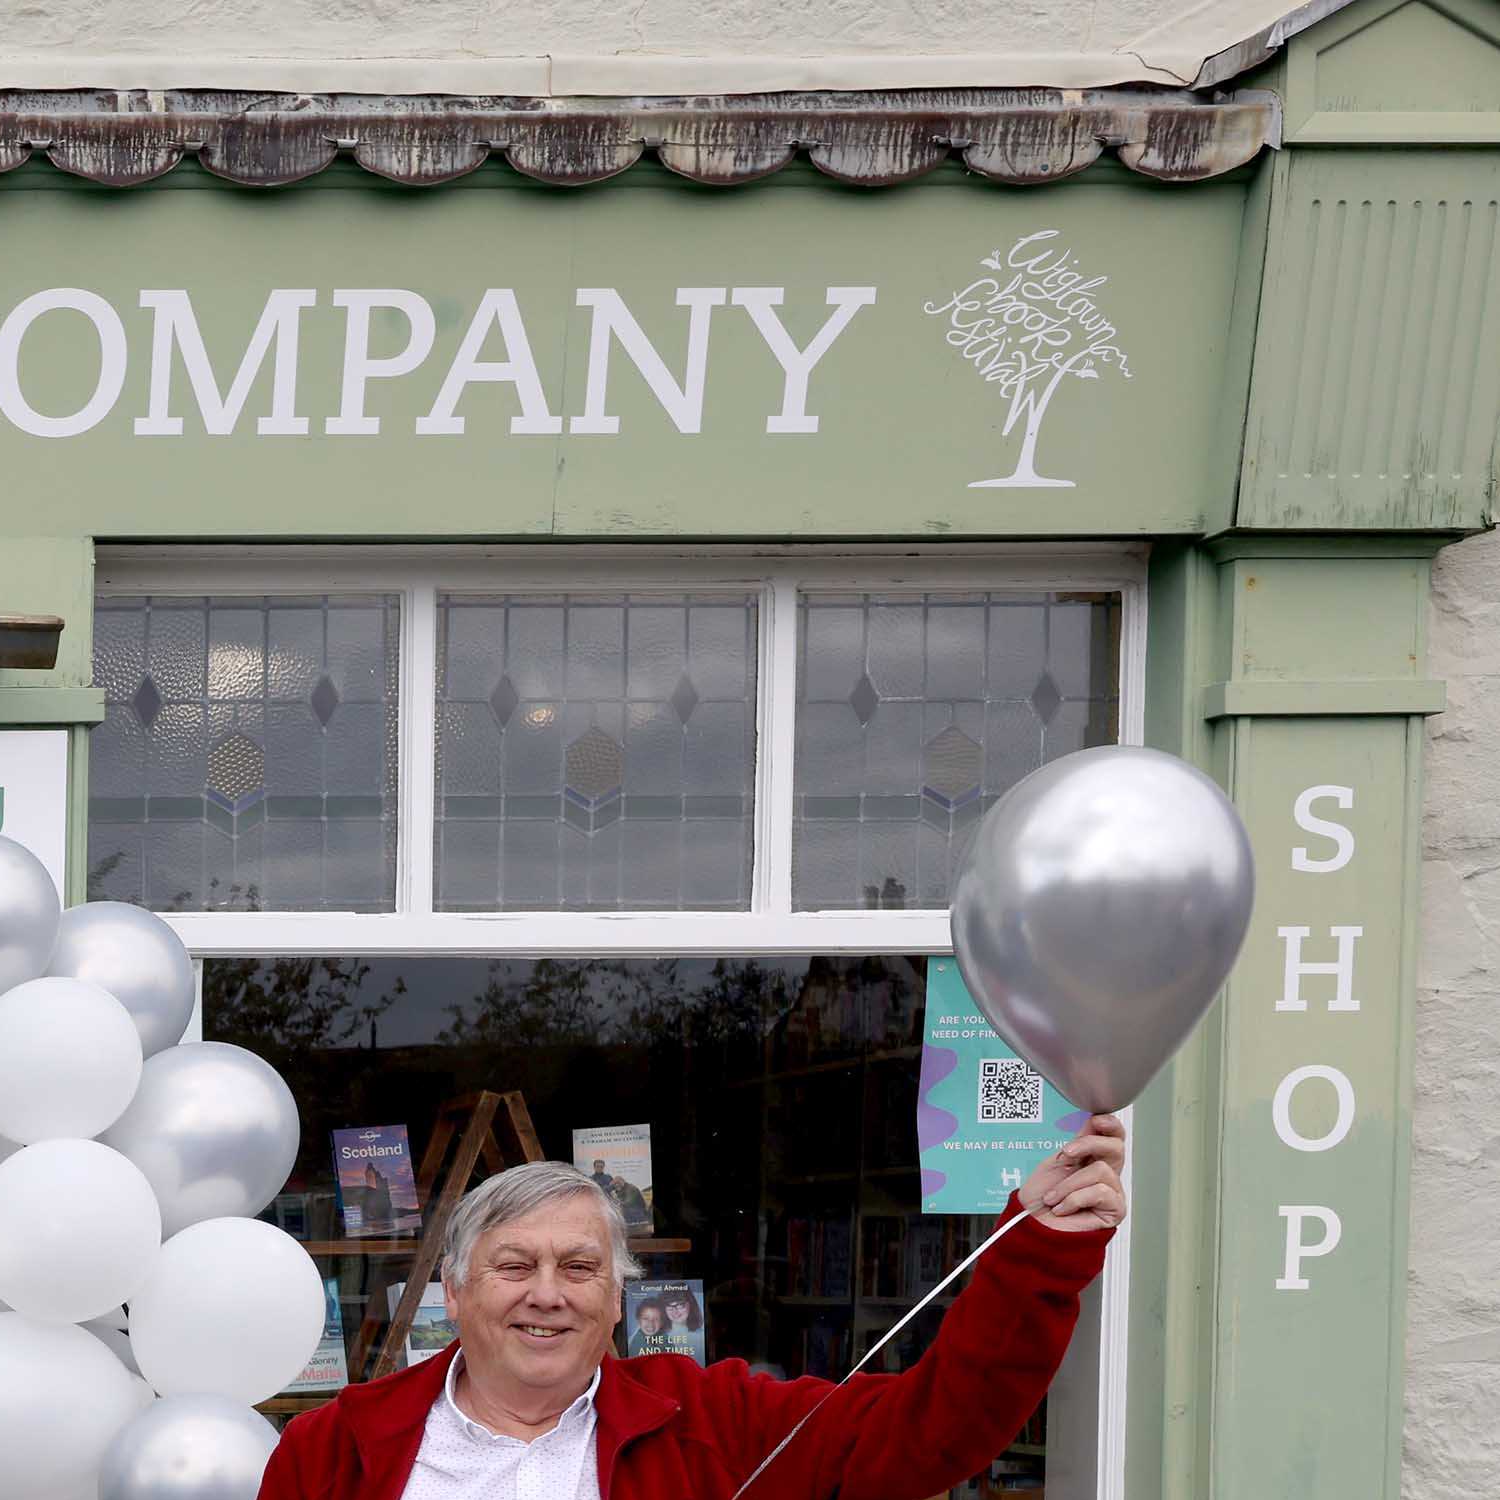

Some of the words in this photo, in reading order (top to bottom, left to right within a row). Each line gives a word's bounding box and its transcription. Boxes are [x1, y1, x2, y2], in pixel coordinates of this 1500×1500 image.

[939, 1016, 960, 1025] ARE
[963, 1016, 985, 1025] YOU
[932, 1030, 959, 1039] NEED
[961, 1030, 977, 1038] OF
[979, 1030, 1000, 1039] FIN
[1272, 785, 1363, 1290] SHOP
[943, 1141, 961, 1150] WE
[964, 1141, 988, 1150] MAY
[991, 1141, 1006, 1150] BE
[1008, 1141, 1033, 1150] ABLE
[1037, 1141, 1051, 1149] TO
[341, 1143, 403, 1159] Scotland
[645, 1335, 664, 1345] THE
[667, 1335, 688, 1344] LIFE
[638, 1346, 660, 1356] AND
[664, 1346, 696, 1355] TIMES
